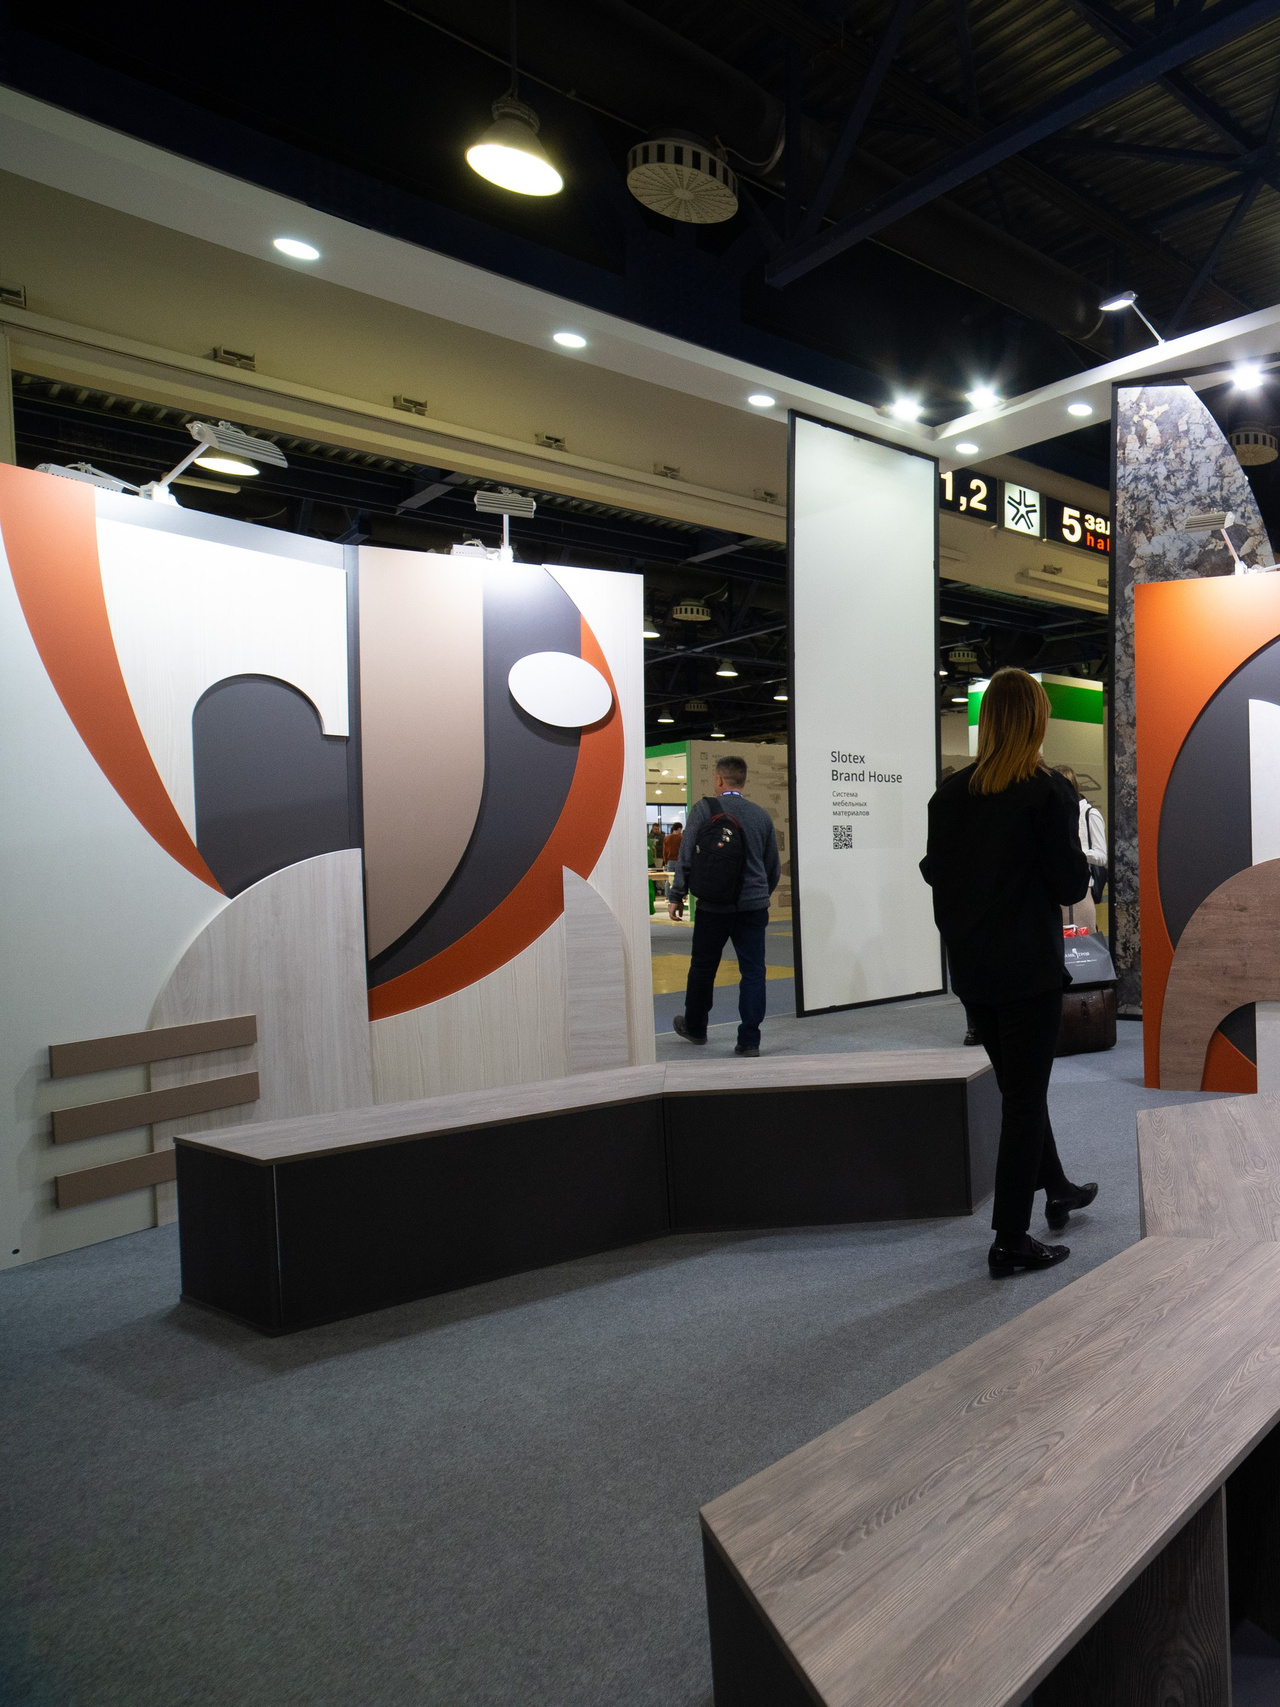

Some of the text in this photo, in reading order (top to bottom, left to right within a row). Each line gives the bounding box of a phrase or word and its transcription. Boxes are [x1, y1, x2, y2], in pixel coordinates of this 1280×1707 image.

[940, 471, 988, 512] 1,2
[1062, 506, 1082, 543] 5
[831, 751, 865, 764] Slotex
[831, 769, 903, 783] Brand House
[832, 790, 858, 798] Система
